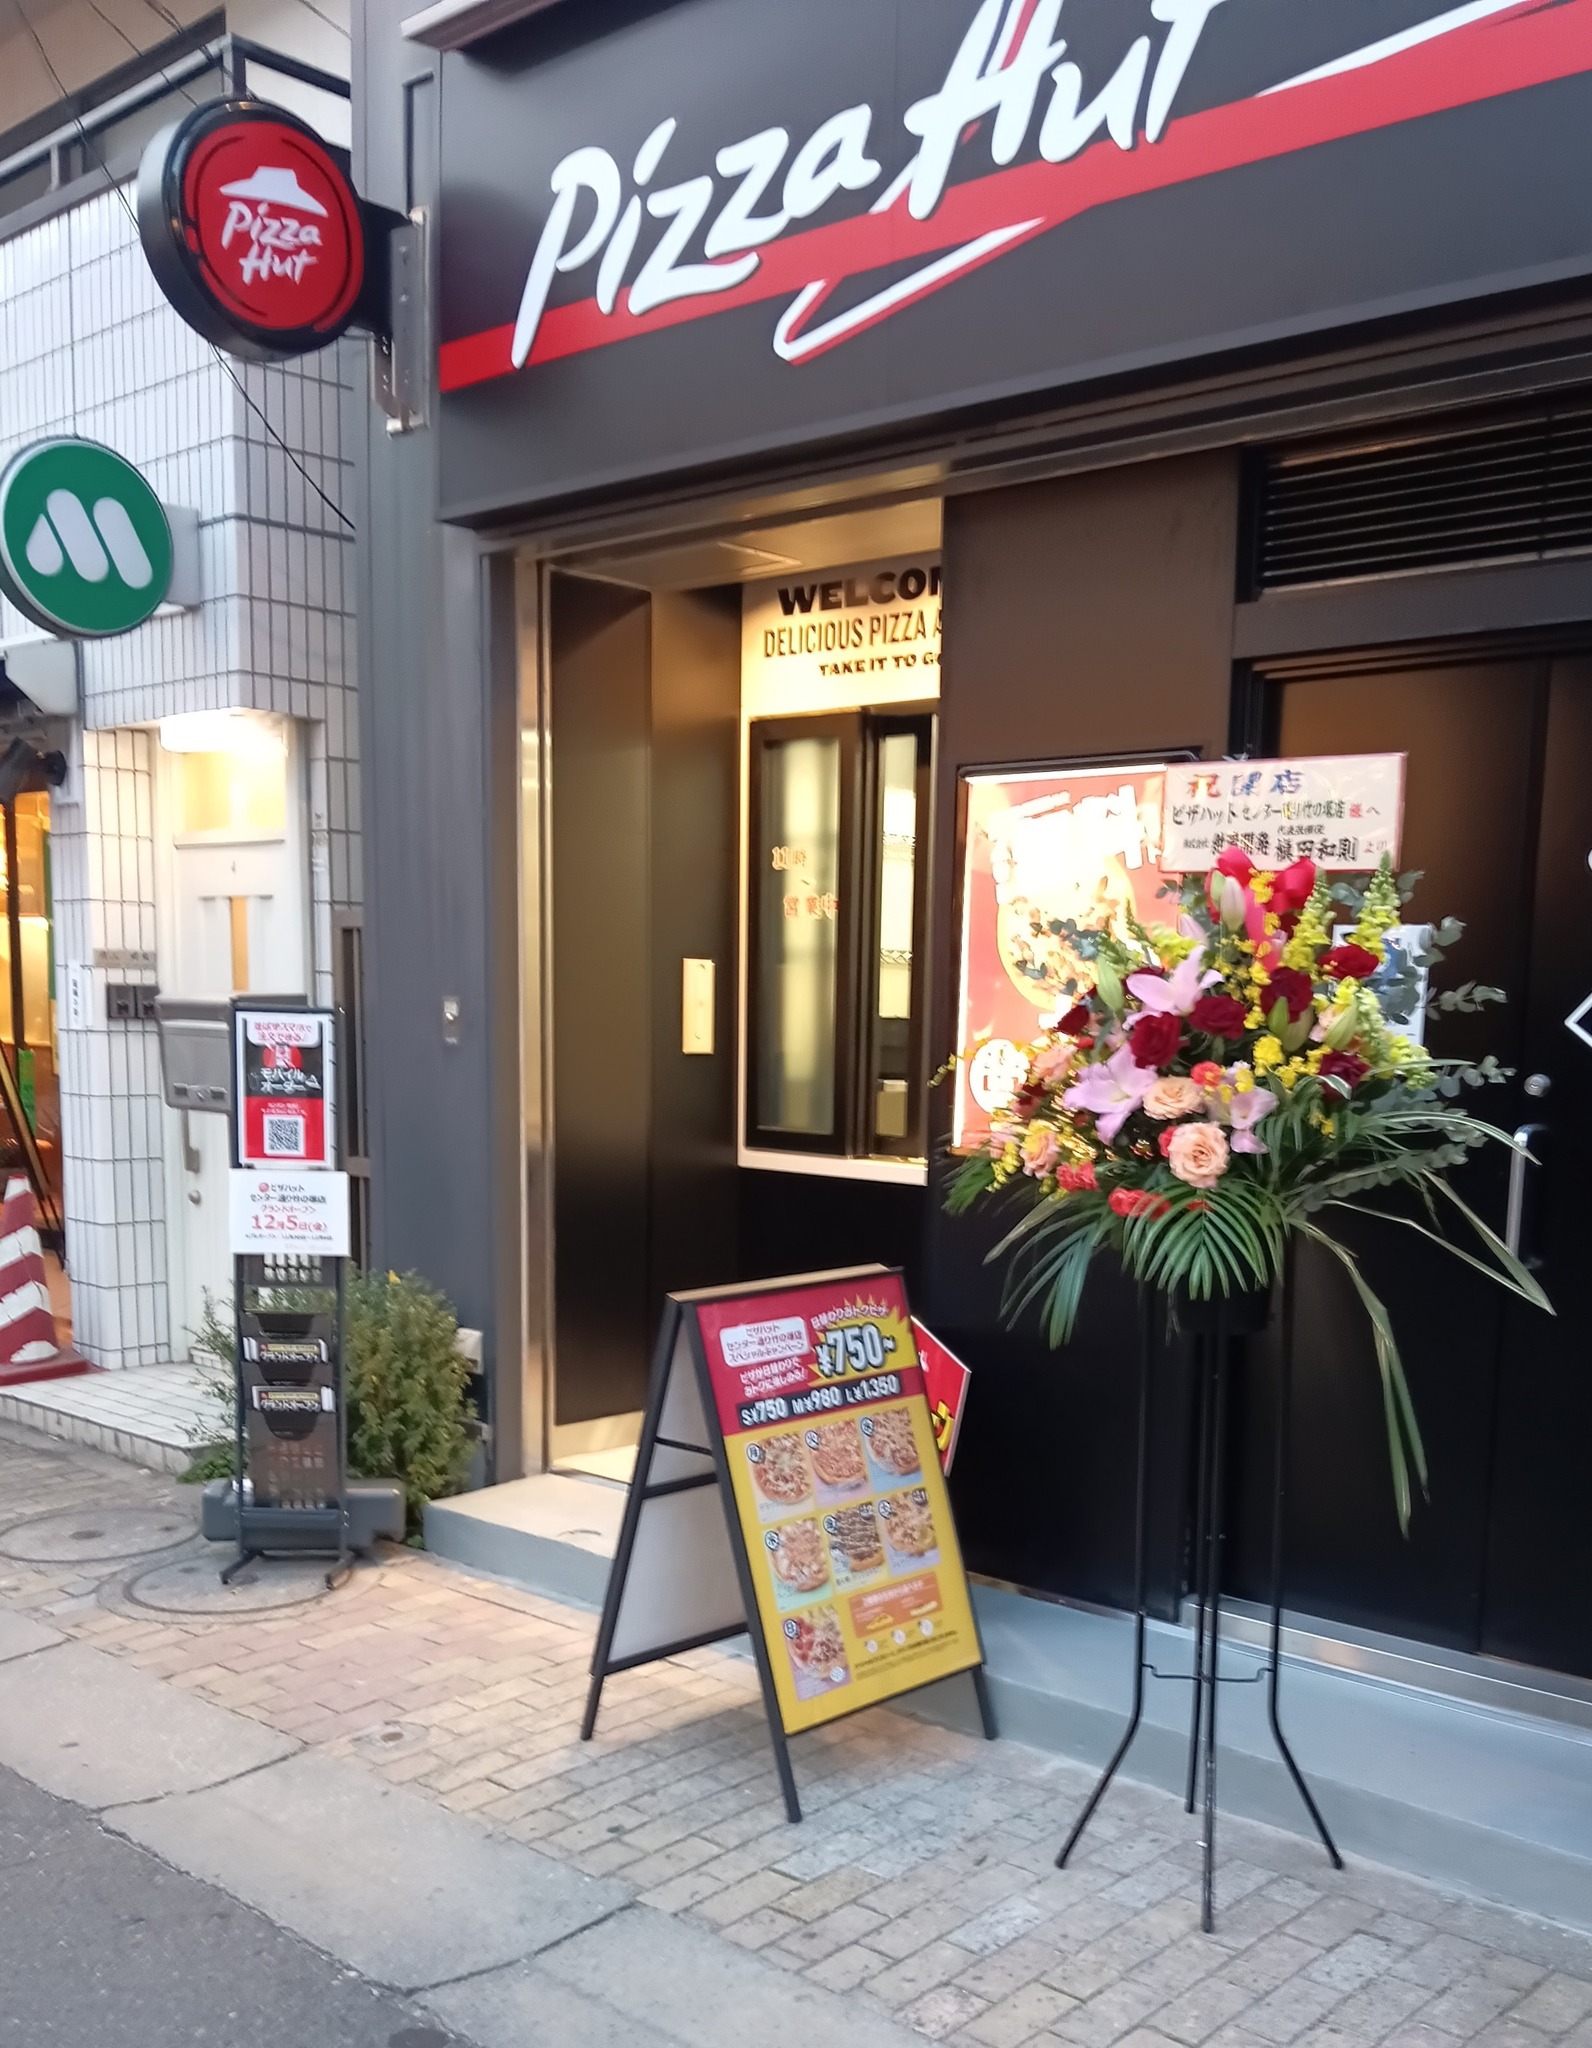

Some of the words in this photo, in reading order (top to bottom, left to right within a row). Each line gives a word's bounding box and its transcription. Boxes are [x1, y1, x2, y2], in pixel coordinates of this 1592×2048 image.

[511, 105, 882, 368] Pizza
[868, 0, 1222, 220] Hut
[221, 201, 323, 249] Pizza
[239, 243, 319, 286] Hut
[764, 617, 864, 657] DELICIOUS
[869, 609, 927, 646] PIZZA
[819, 660, 866, 676] TAKE
[870, 657, 888, 671] IT
[893, 653, 917, 668] TO
[261, 1205, 316, 1214] グランドオープン
[271, 1184, 305, 1192] ピザハット
